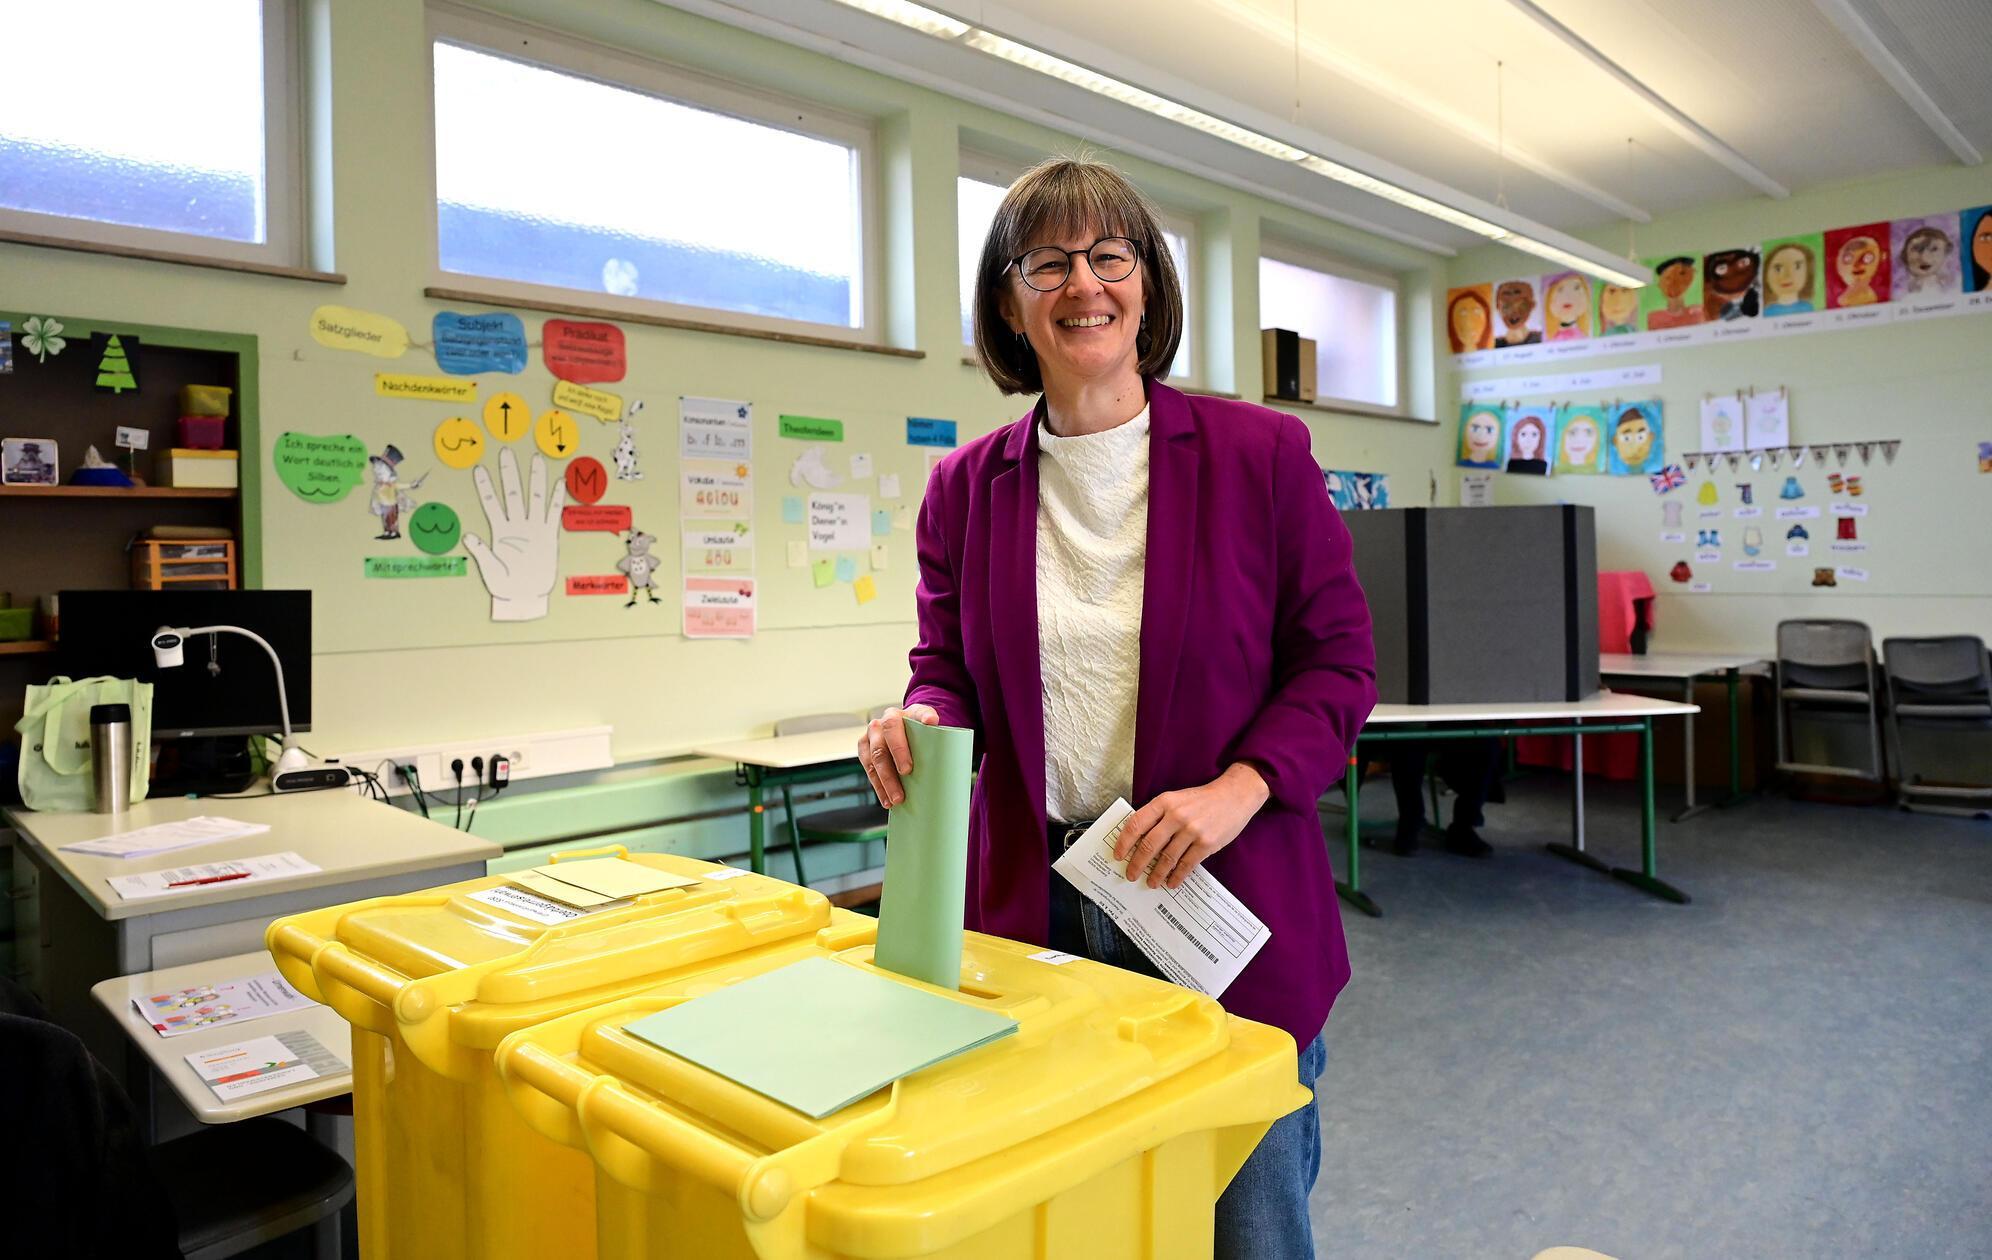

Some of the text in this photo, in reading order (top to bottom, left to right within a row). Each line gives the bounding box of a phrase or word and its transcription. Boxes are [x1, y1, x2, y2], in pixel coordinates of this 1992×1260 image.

[318, 319, 382, 343] Satzglieder
[457, 317, 505, 333] Subjekt
[382, 380, 467, 397] Nachdenkwörter
[284, 438, 302, 449] Ich
[306, 440, 345, 454] spreche
[282, 454, 310, 465] Wort
[313, 456, 353, 469] deutlich
[574, 466, 598, 496] M
[812, 530, 835, 544] Vogel
[372, 561, 458, 574] Mitsprechwörter
